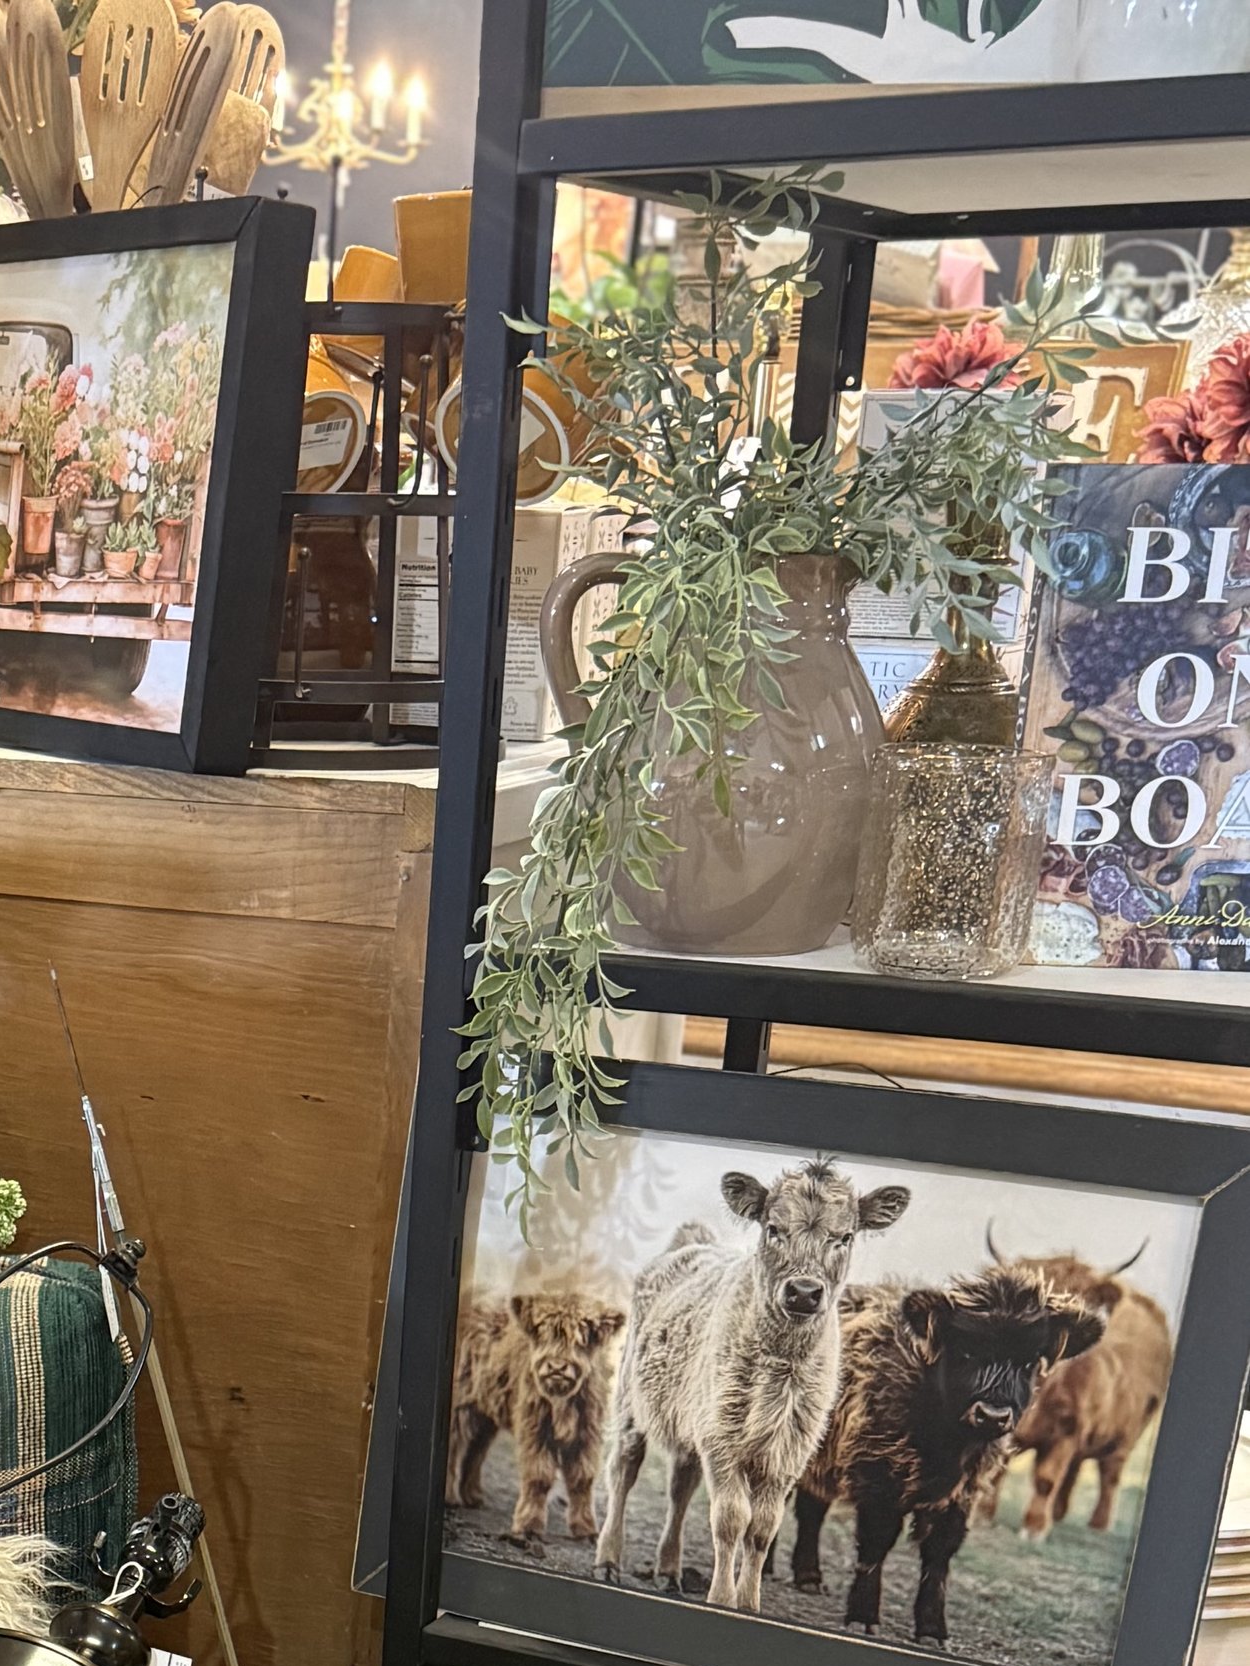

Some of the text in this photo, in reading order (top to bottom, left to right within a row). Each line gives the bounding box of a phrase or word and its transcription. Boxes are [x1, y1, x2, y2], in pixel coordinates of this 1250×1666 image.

[1116, 526, 1240, 604] BI
[869, 661, 907, 678] TIC
[878, 684, 904, 700] RY
[1136, 904, 1218, 929] Anni
